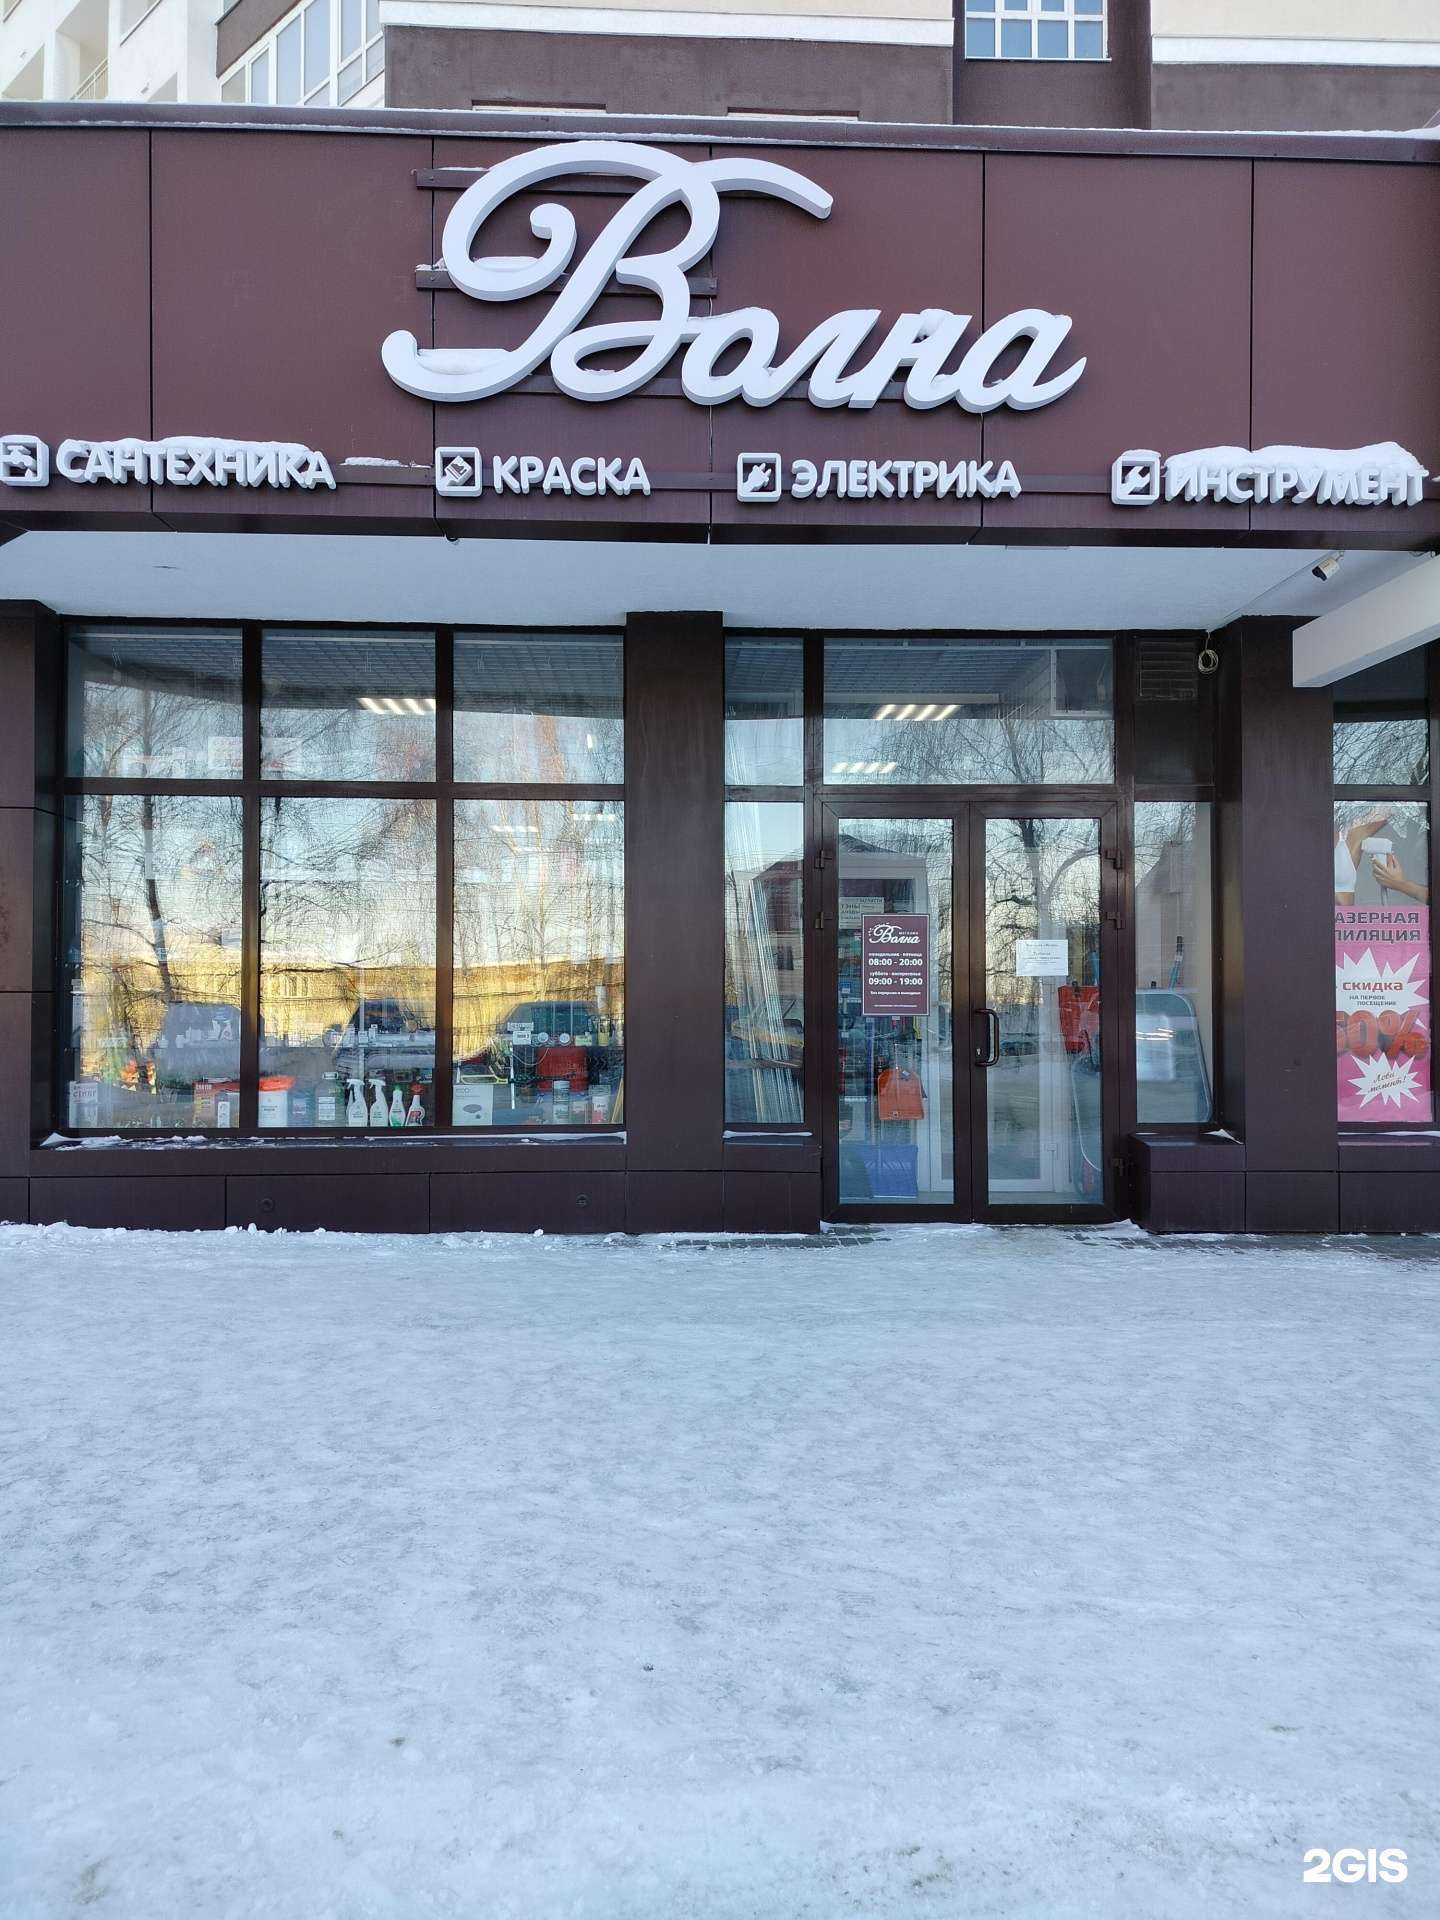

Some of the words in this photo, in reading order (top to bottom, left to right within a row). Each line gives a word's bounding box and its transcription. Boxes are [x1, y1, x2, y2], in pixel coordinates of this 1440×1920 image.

[382, 140, 1087, 413] Волна
[57, 440, 336, 490] САНТЕХНИКА
[493, 455, 651, 496] КРАСКА
[792, 458, 1022, 499] ЭЛЕКТРИКА
[1165, 456, 1426, 506] ИНСТРУМЕНТ
[868, 924, 921, 944] Волна
[868, 958, 892, 966] 08:00
[899, 958, 923, 966] 20:00
[868, 977, 892, 985] 09:00
[899, 977, 923, 985] 19:00
[1343, 981, 1403, 992] скидка
